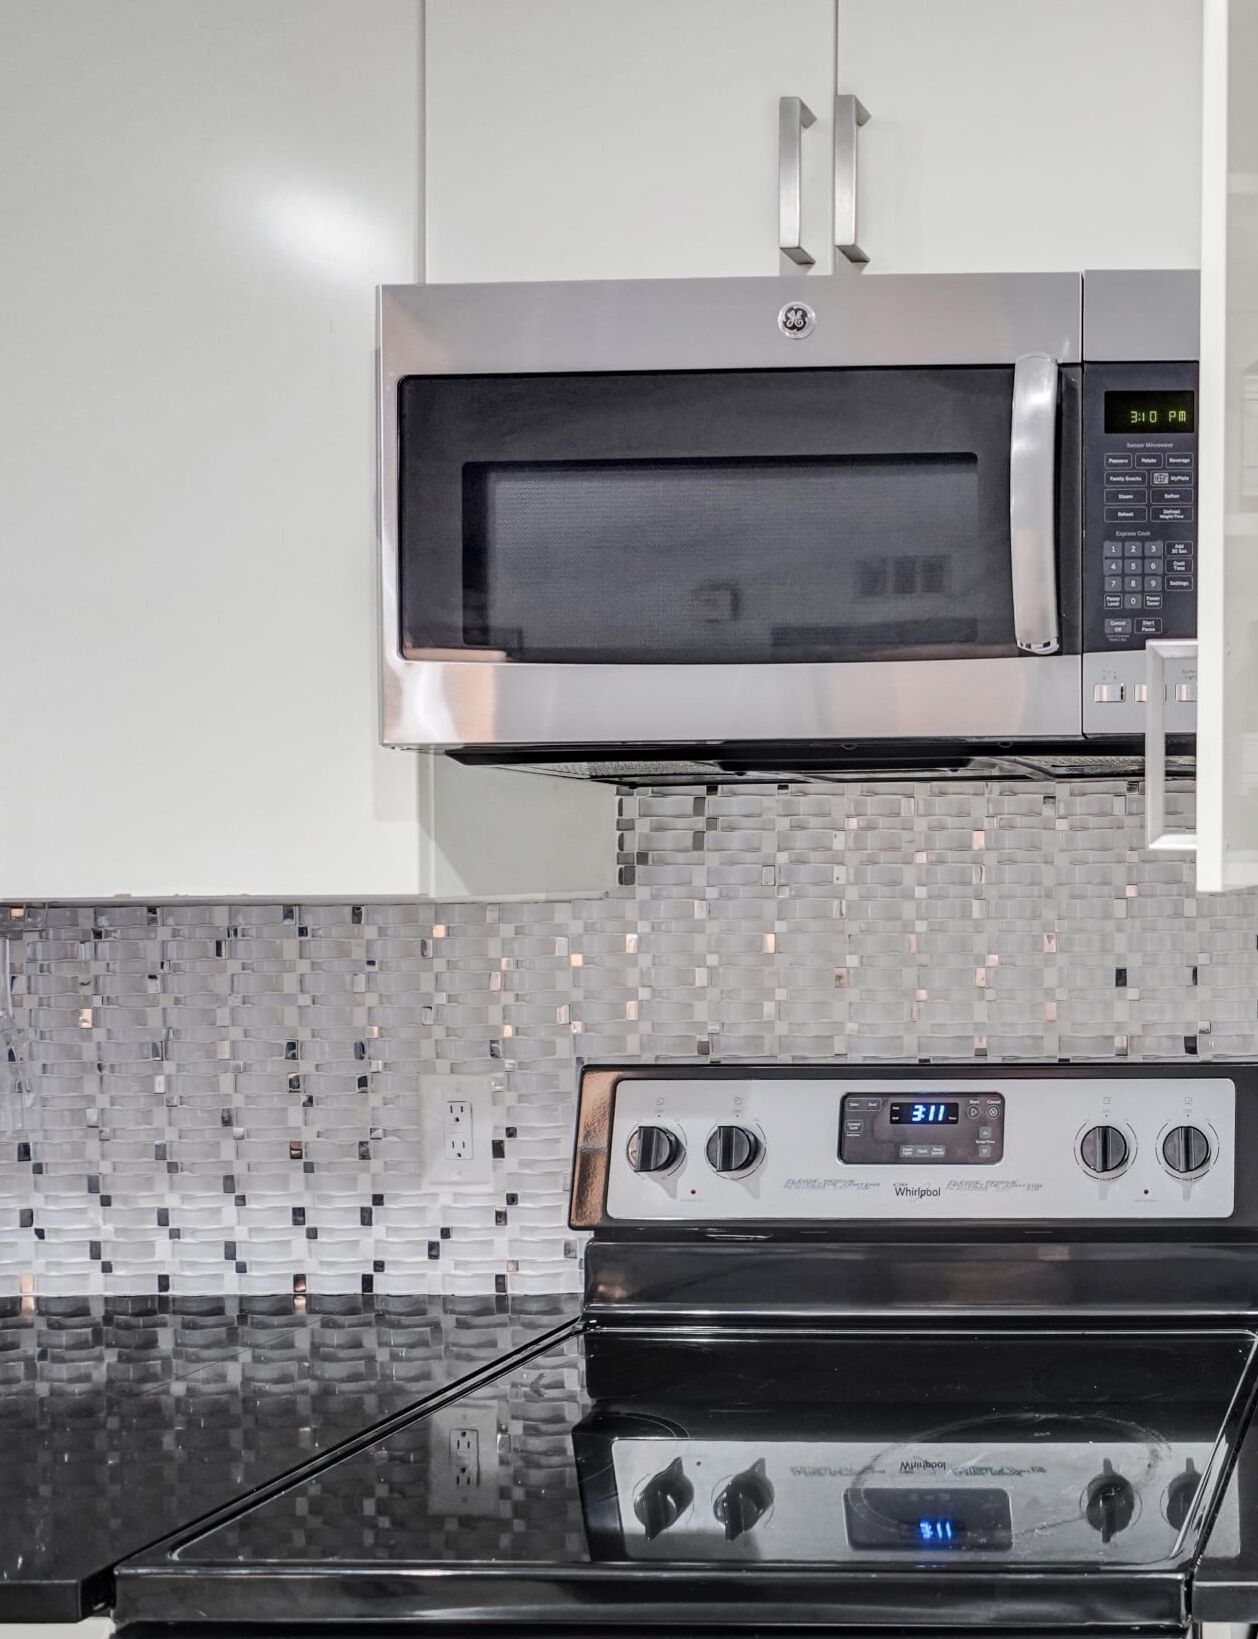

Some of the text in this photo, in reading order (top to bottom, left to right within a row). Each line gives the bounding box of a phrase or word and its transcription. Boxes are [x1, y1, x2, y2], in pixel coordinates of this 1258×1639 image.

[1130, 410, 1186, 423] 3:10 PM
[1130, 597, 1136, 605] 0
[911, 1104, 946, 1122] 3:11
[895, 1187, 941, 1199] Whirlpool
